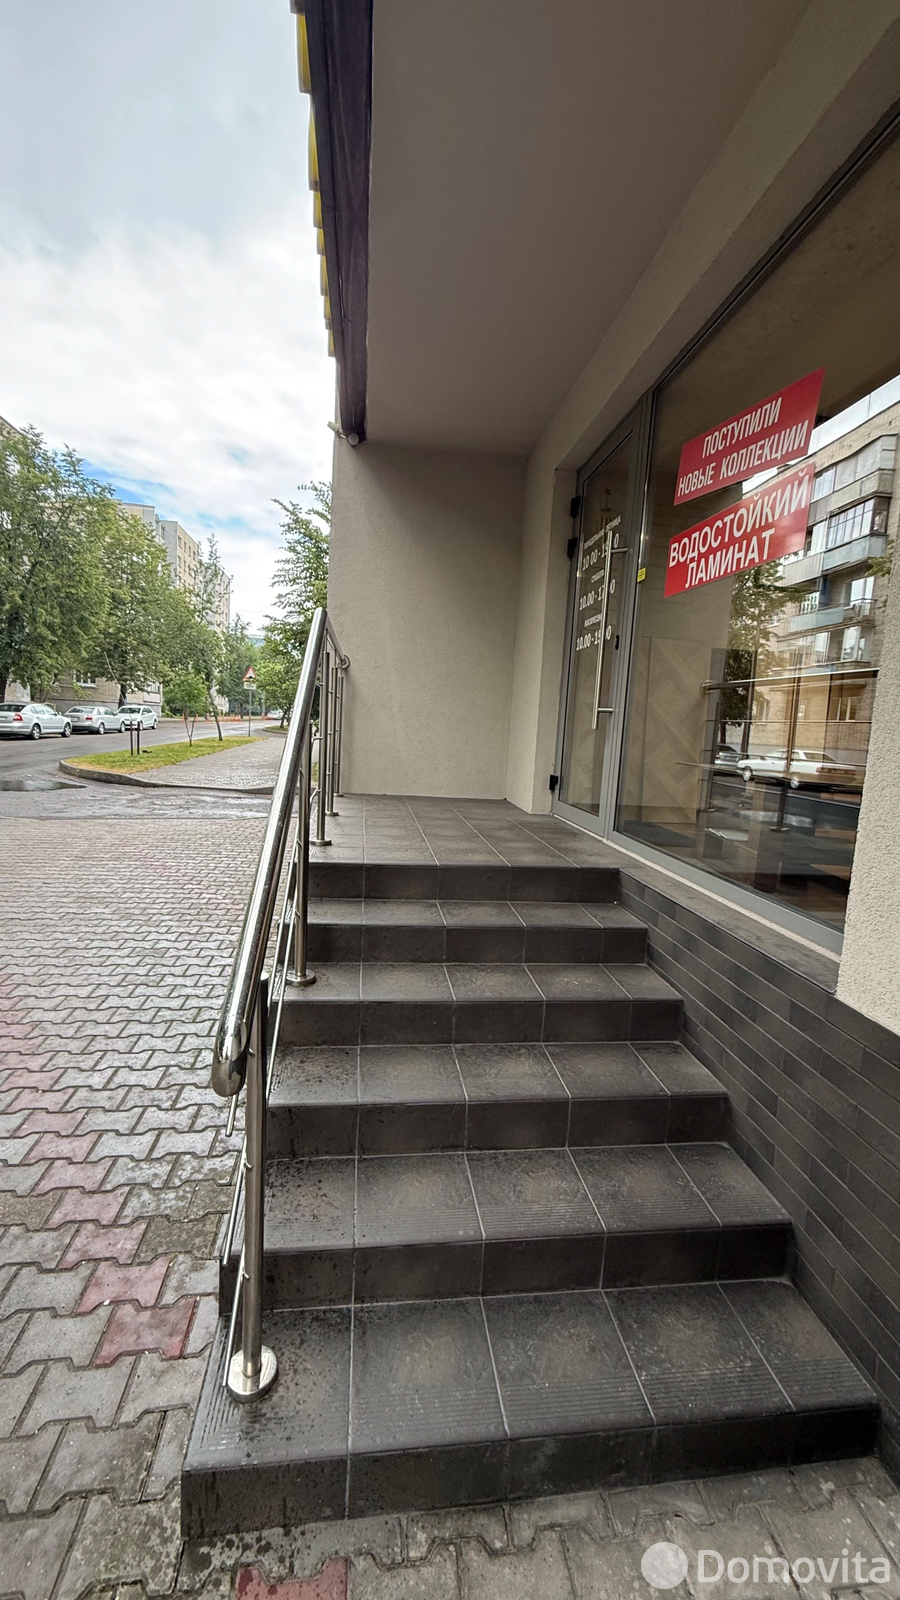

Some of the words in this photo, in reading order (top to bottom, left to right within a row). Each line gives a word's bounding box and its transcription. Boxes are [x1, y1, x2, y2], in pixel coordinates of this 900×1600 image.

[677, 462, 716, 497] НОВЫЕ
[719, 420, 809, 480] КОЛЛЕКЦИИ
[702, 397, 782, 458] ПОСТУПИЛИ
[668, 468, 810, 568] ВОДОСТОЙКИЙ
[685, 528, 775, 589] ЛАМИНАТ
